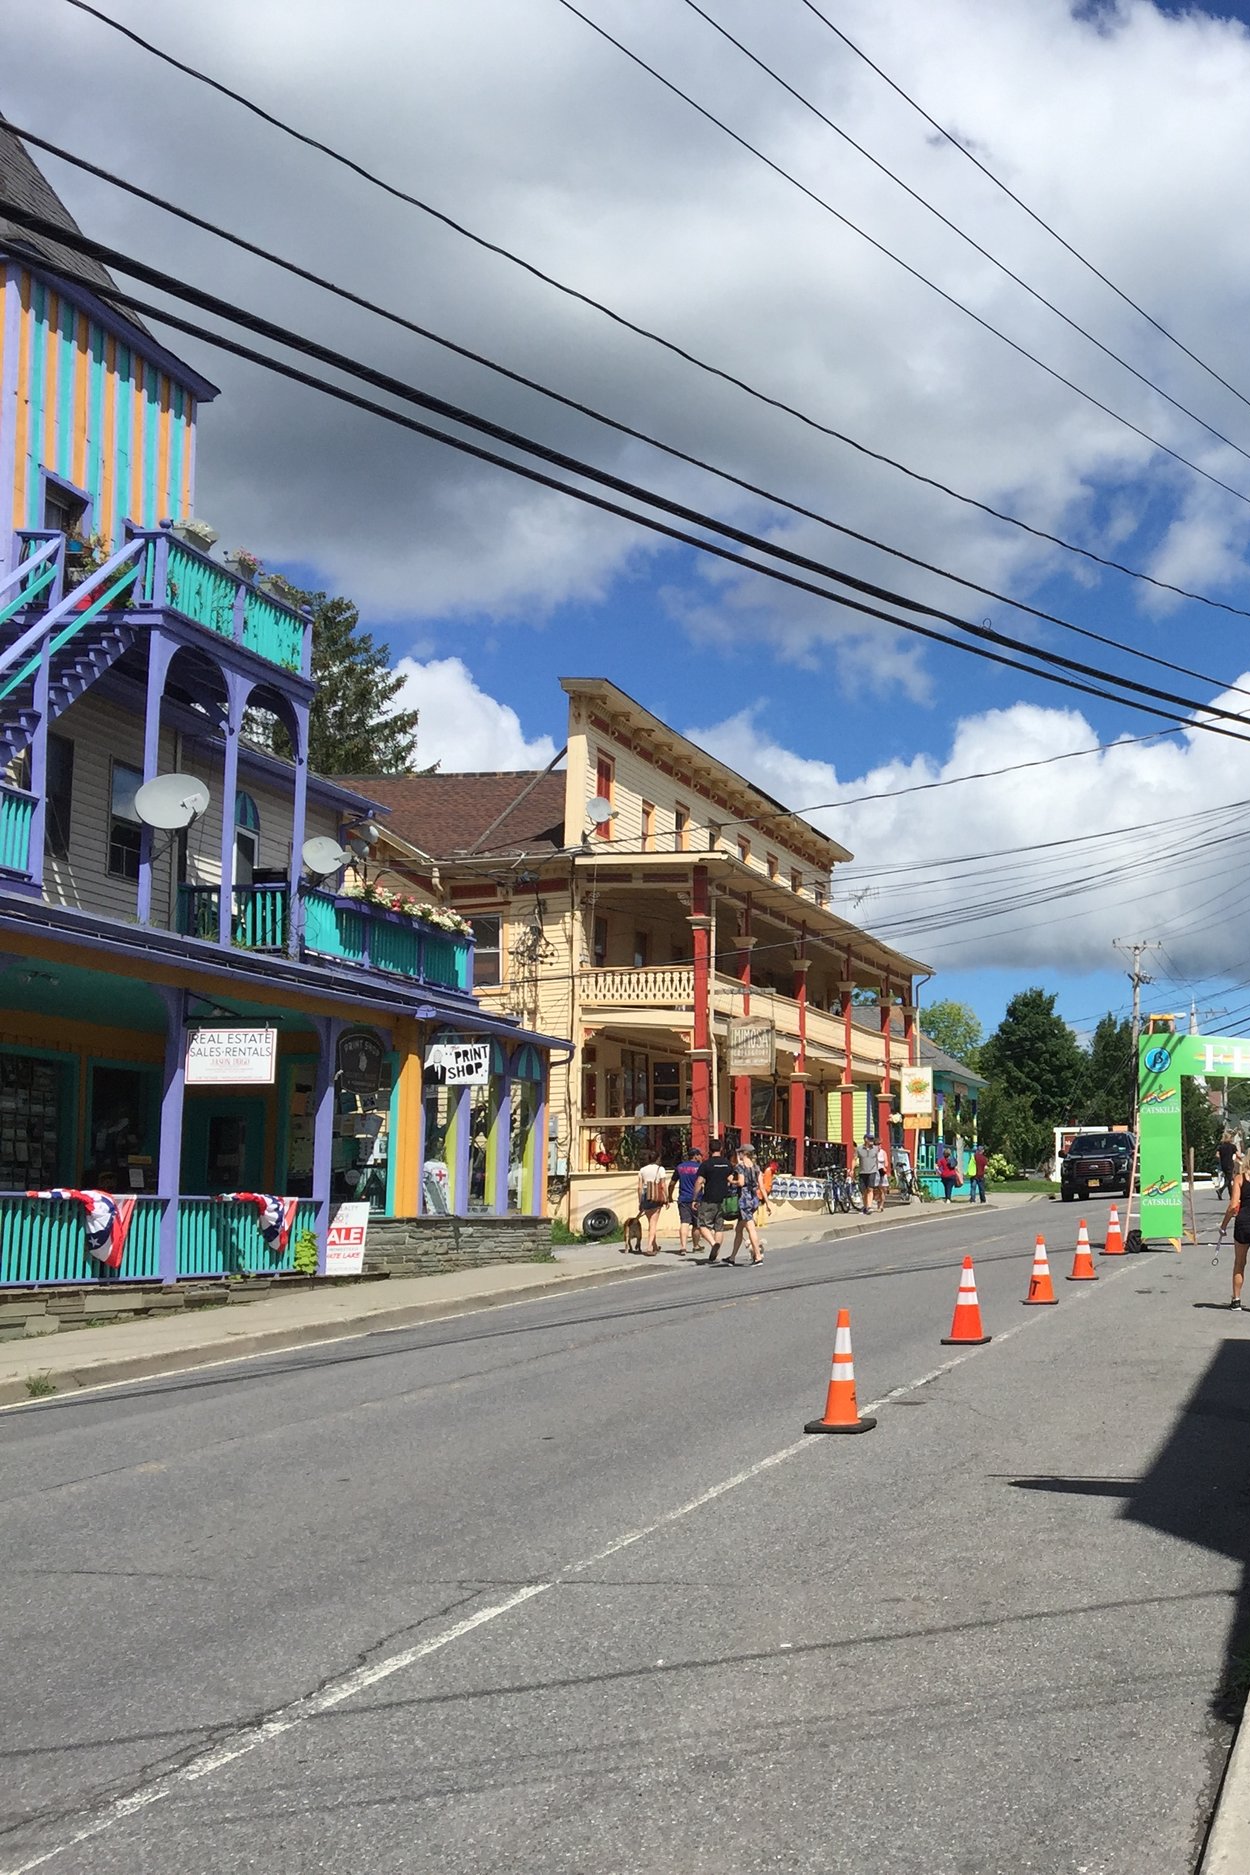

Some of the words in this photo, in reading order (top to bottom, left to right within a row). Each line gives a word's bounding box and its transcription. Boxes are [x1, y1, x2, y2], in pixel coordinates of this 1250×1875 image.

[192, 1033, 223, 1045] REAL
[227, 1033, 272, 1044] ESTATE
[454, 1045, 488, 1065] PRINT
[447, 1062, 483, 1080] SHOP
[1141, 1105, 1181, 1115] CATSKILLS
[1142, 1198, 1183, 1207] CATSKILLS
[326, 1228, 362, 1245] ALE
